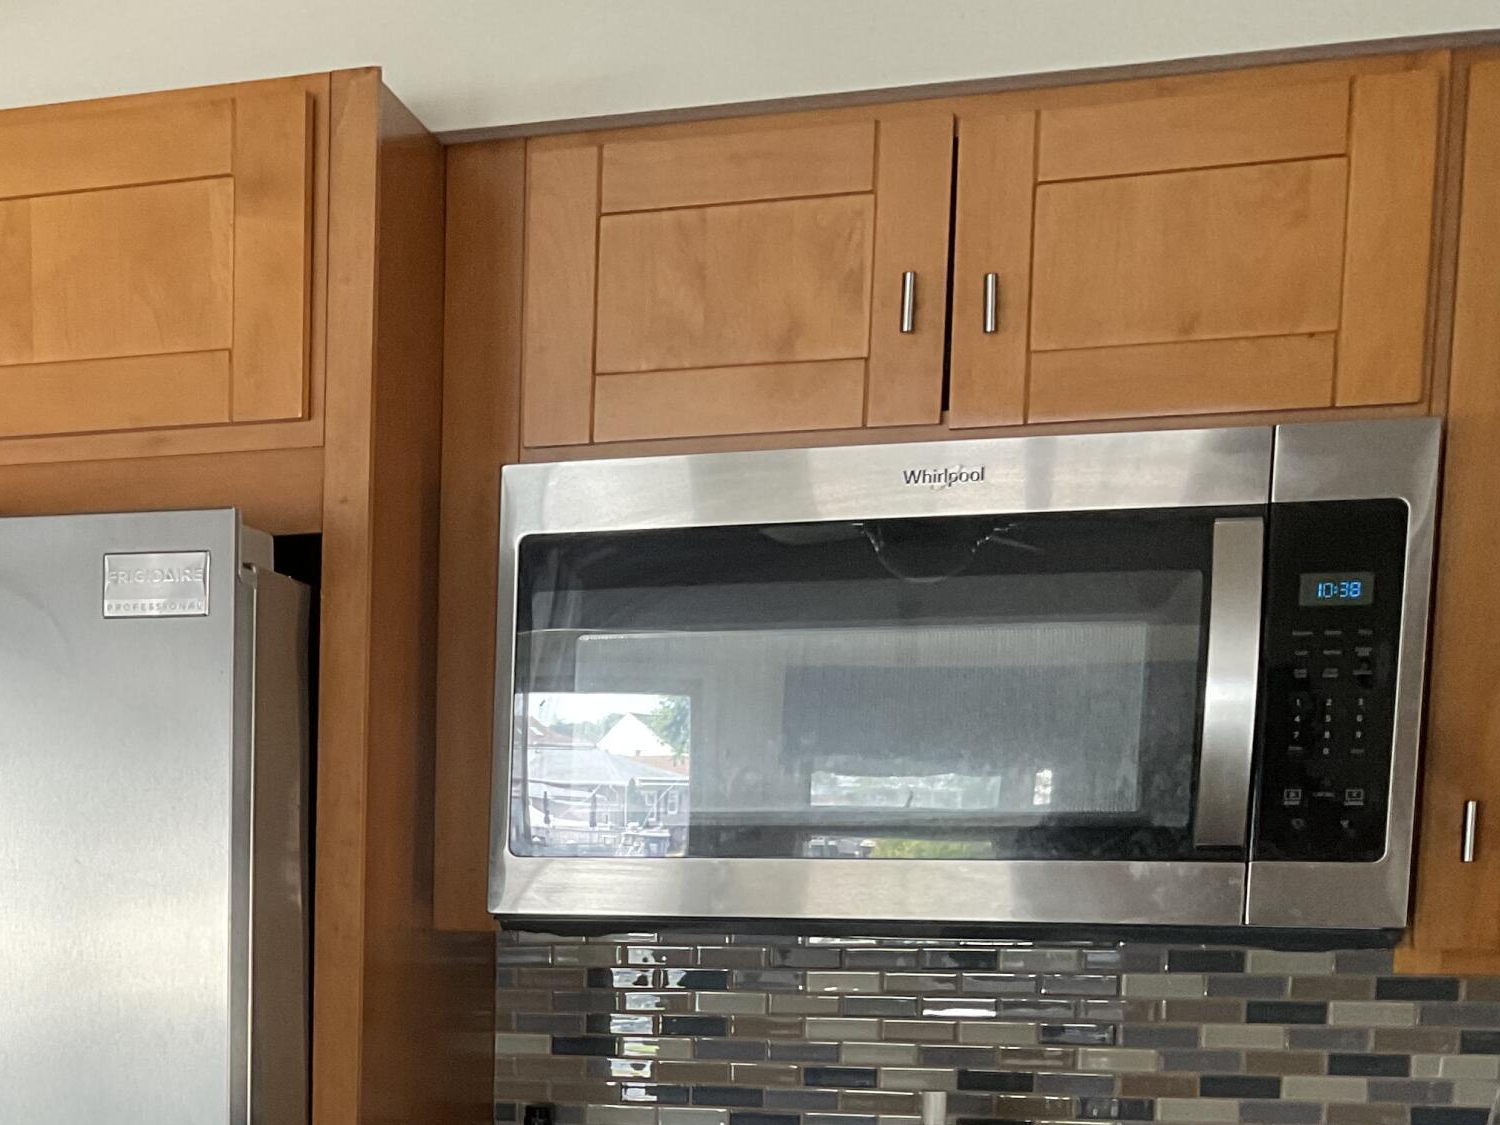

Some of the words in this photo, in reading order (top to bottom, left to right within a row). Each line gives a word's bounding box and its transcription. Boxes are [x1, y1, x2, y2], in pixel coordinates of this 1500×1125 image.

[903, 467, 985, 487] Whirlpool
[109, 568, 204, 584] FRIGIDAIRE
[1318, 582, 1361, 598] 10:38
